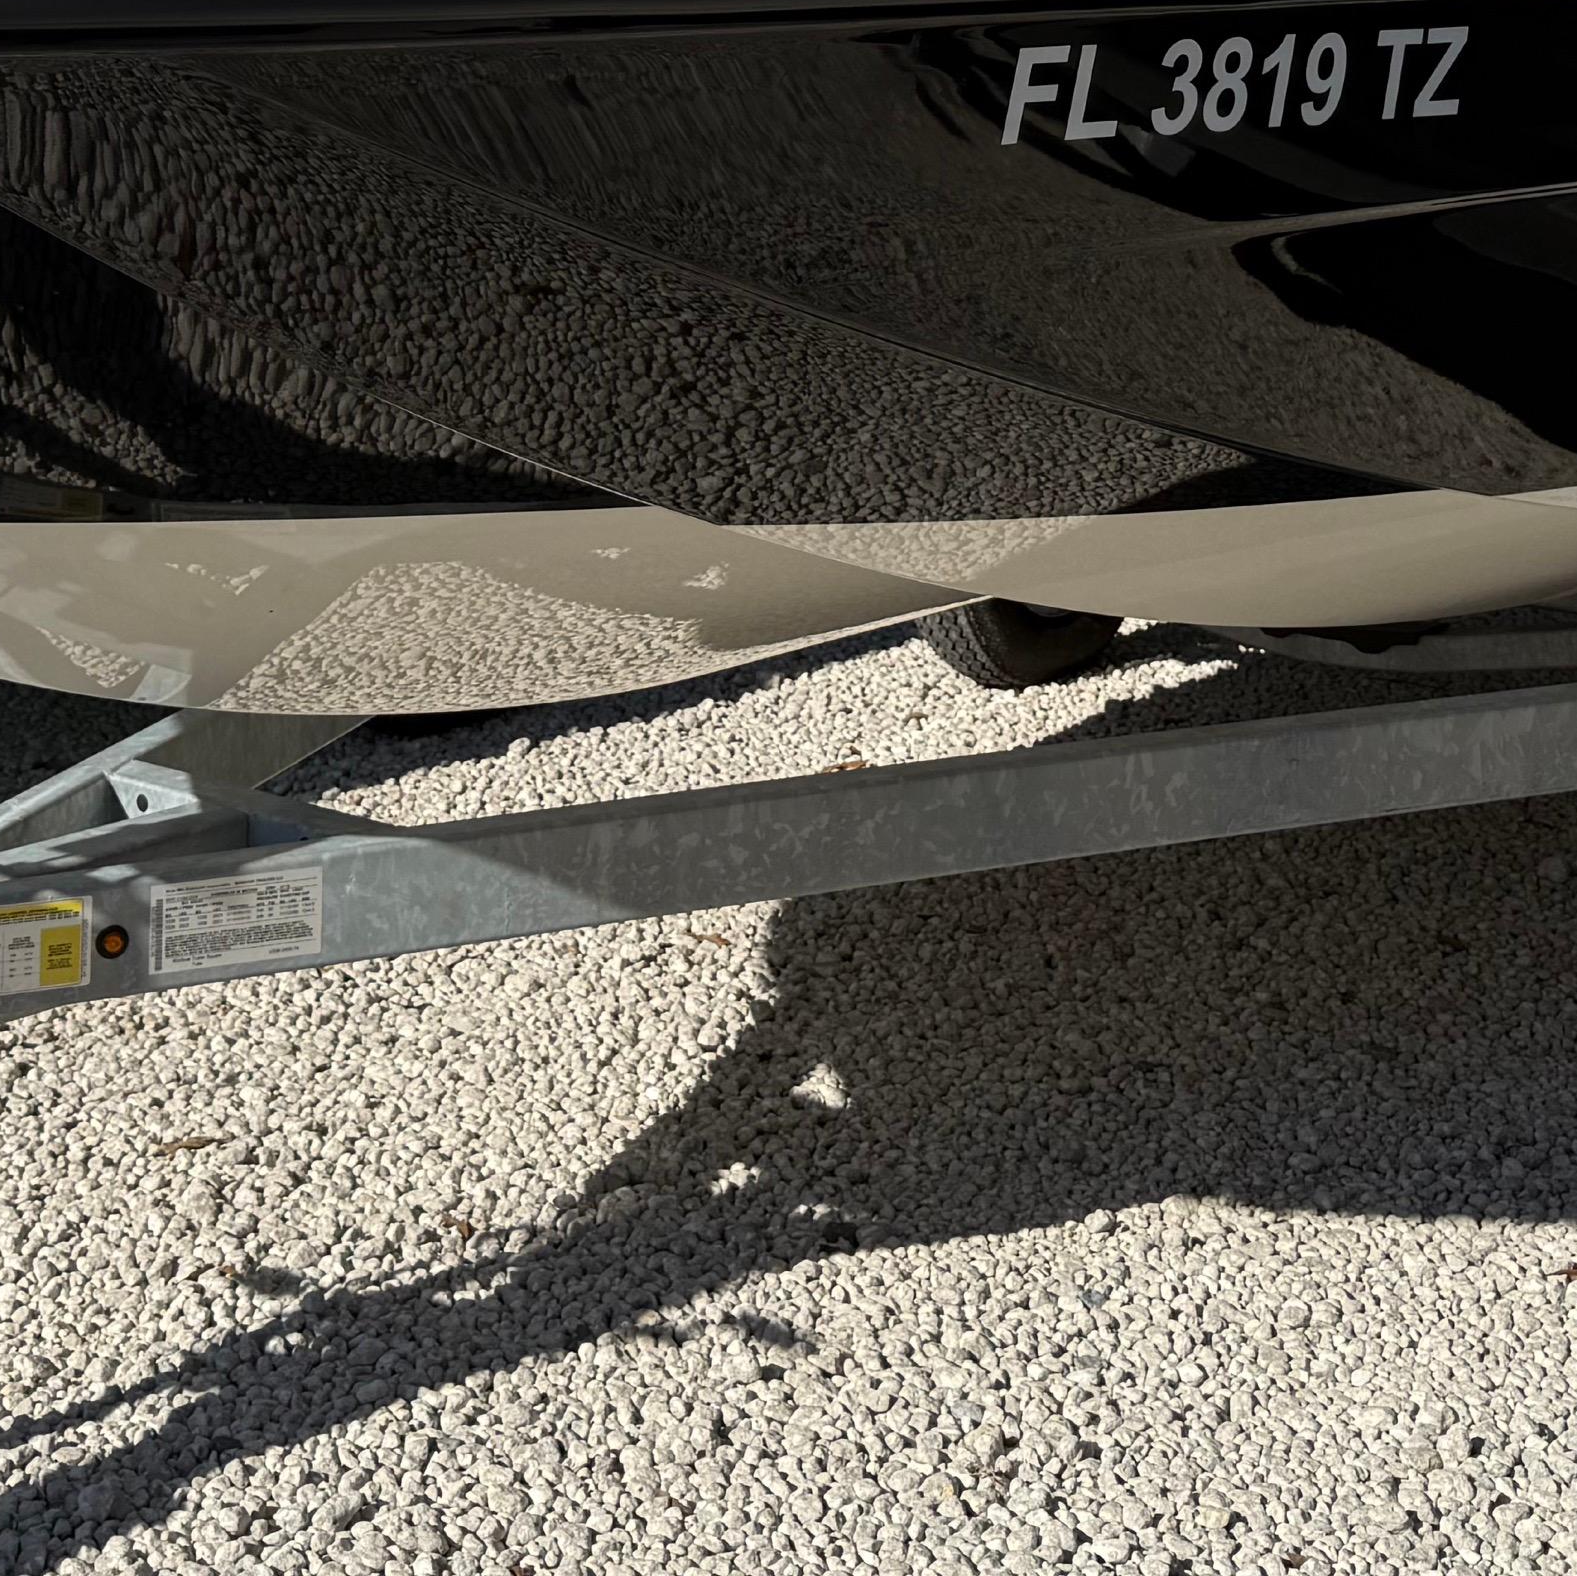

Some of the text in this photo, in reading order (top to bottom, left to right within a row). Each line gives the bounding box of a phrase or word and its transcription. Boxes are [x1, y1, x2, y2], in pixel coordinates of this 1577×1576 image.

[1000, 26, 1470, 146] FL 3819 TZ
